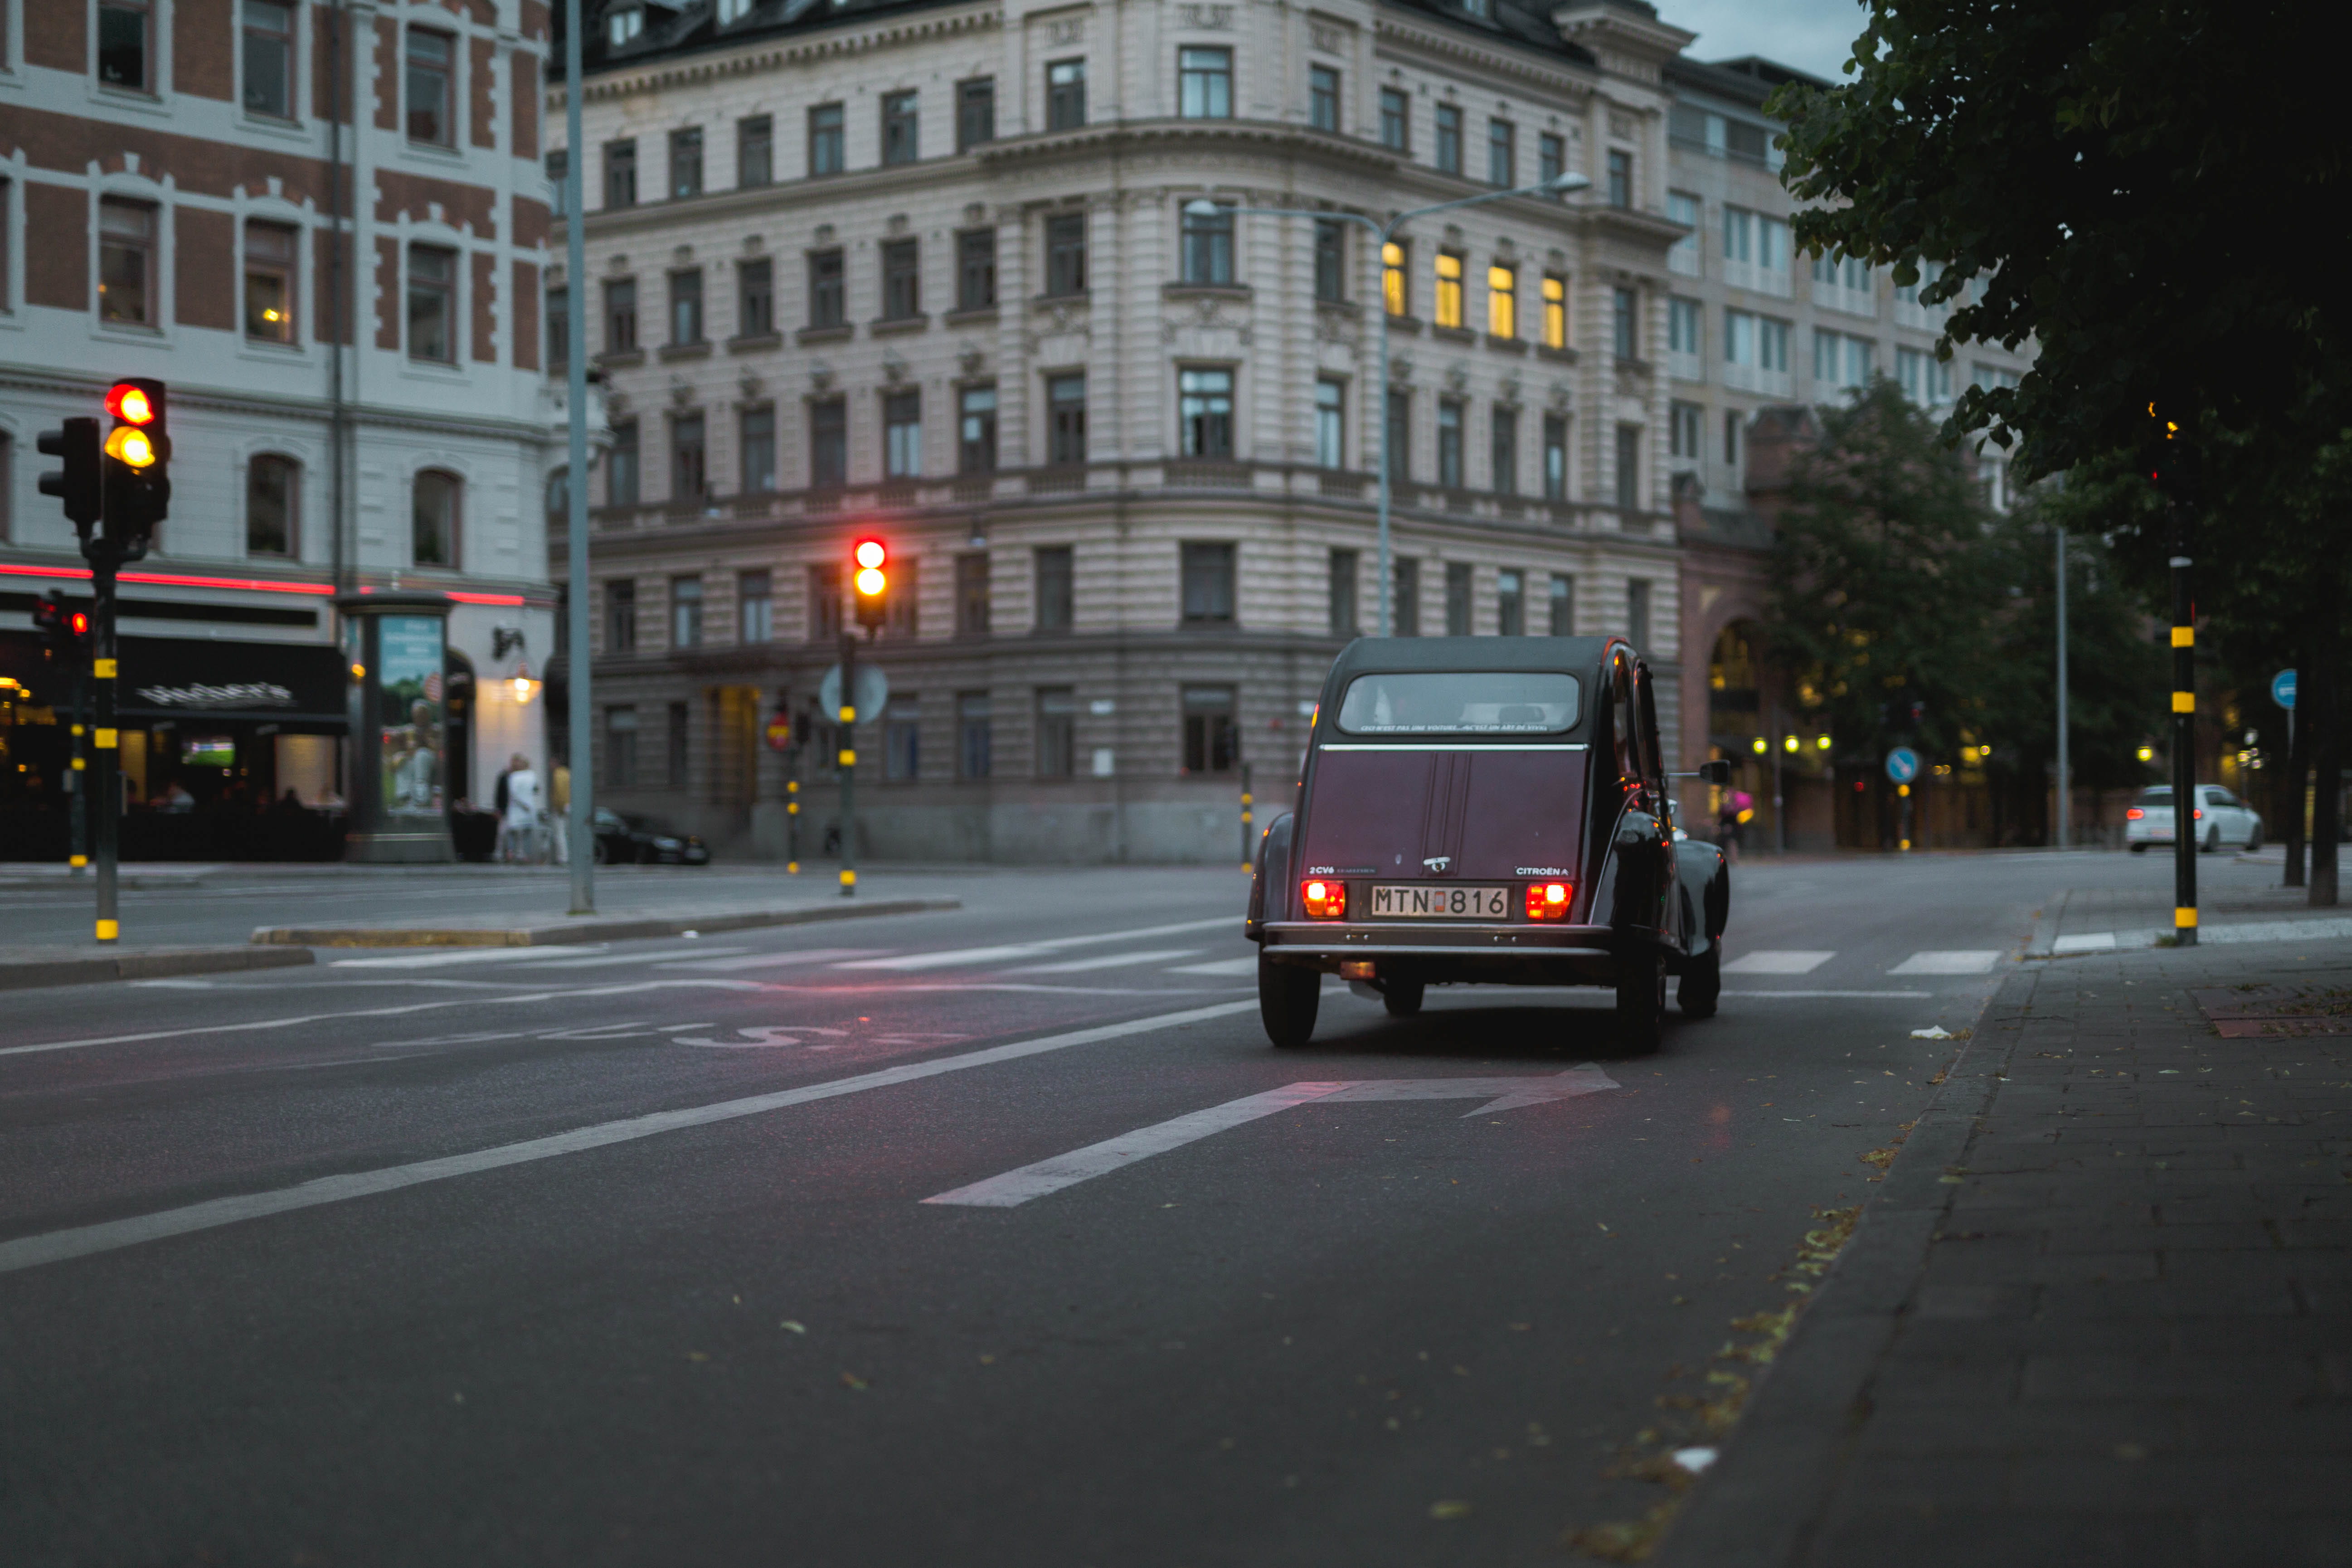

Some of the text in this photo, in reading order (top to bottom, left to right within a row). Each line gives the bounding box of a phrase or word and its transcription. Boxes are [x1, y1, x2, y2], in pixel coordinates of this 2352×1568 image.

[1309, 866, 1334, 874] 2CV6
[1516, 867, 1560, 875] CITROËN
[1375, 888, 1504, 913] MTN 816
